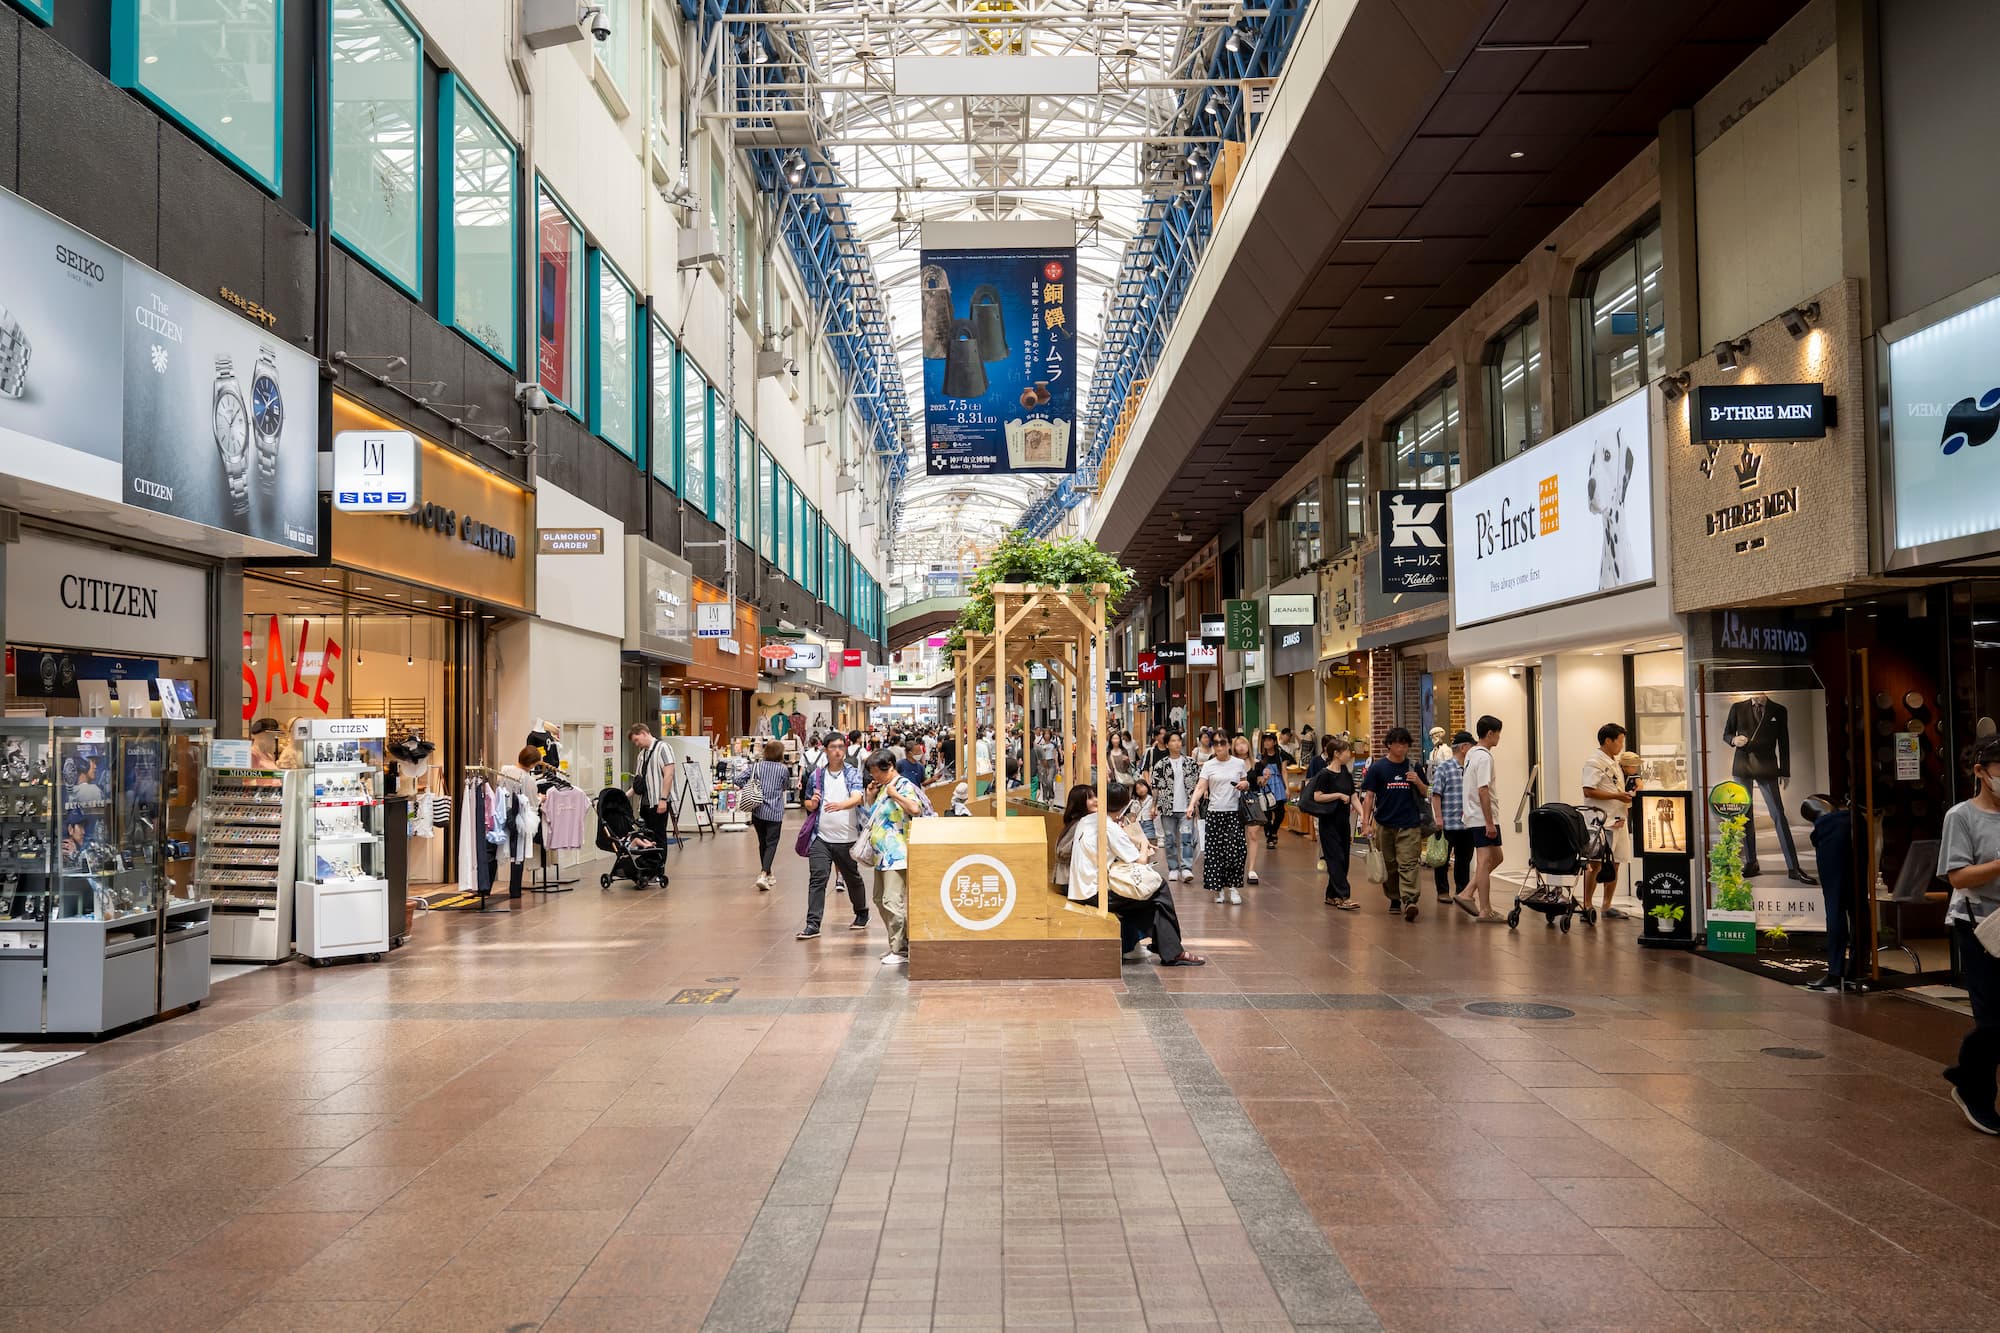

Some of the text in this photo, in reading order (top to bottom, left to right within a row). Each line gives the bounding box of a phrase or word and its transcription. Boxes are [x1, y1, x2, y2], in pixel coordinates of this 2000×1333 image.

[56, 244, 105, 282] SEIKO
[151, 292, 169, 316] The
[136, 306, 184, 344] CITIZEN
[1043, 283, 1066, 382] 銅鐸とムラ
[1710, 404, 1813, 421] B-THREE MEN
[134, 477, 173, 502] CITIZEN
[1706, 486, 1799, 536] B-THREE MEN
[461, 515, 517, 560] GARDEN
[543, 533, 598, 541] GLAMOROUS
[1475, 497, 1536, 560] P's-first
[552, 541, 588, 549] GARDEN
[1393, 554, 1442, 567] キールズ
[1402, 573, 1436, 587] Kiehl's
[60, 574, 159, 620] CITIZEN
[1241, 601, 1253, 649] axes
[1191, 648, 1215, 656] JINS
[330, 725, 369, 734] CITIZEN
[952, 893, 1005, 909] プロジェクト
[1788, 900, 1815, 913] MEN
